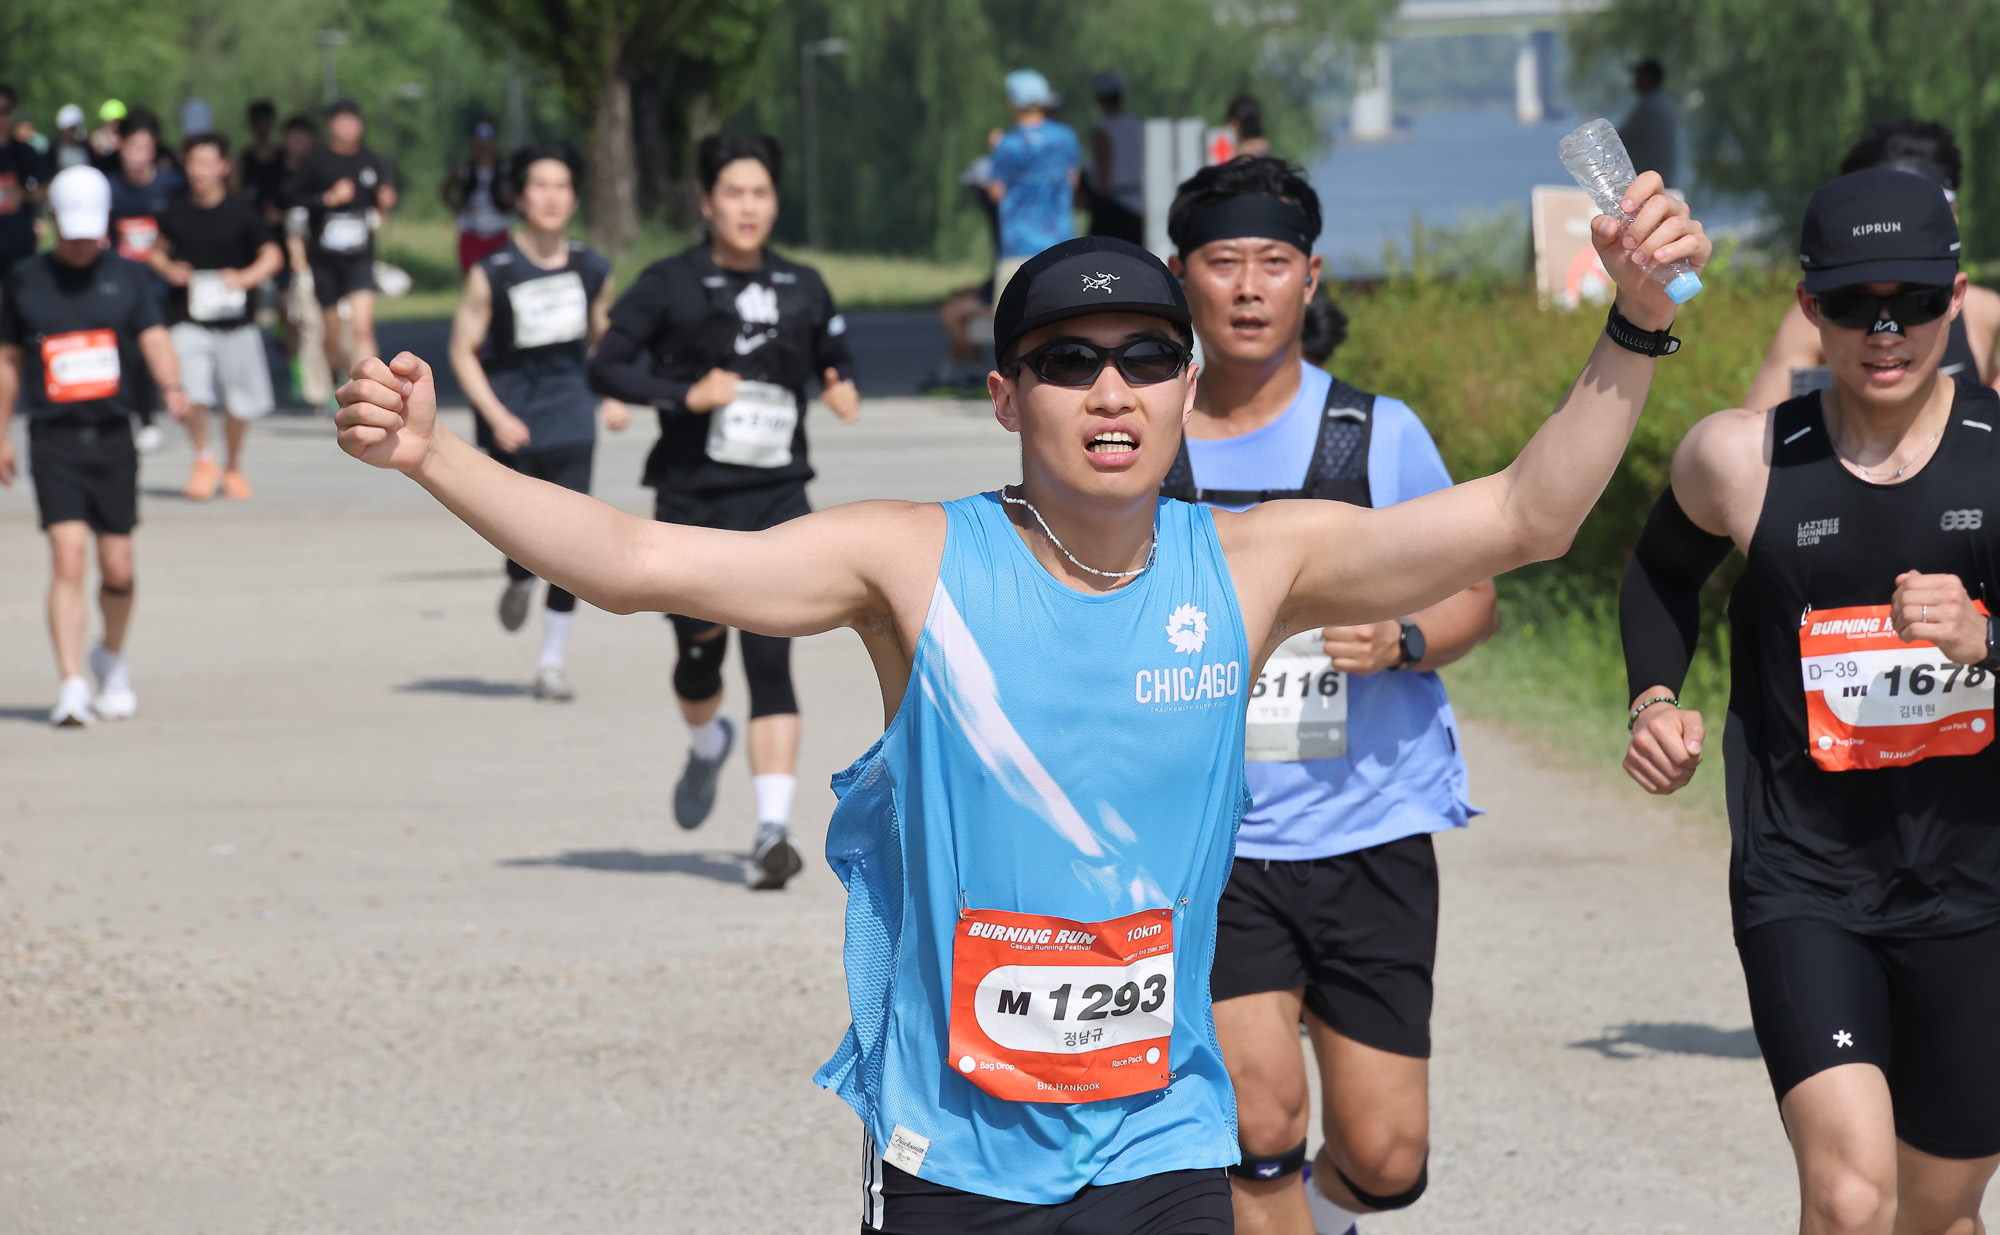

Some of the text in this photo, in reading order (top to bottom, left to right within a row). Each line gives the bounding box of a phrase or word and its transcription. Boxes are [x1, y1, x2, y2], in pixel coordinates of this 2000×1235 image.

[1852, 221, 1901, 237] KIPRUN
[1797, 536, 1820, 547] CLUB
[1810, 618, 1880, 636] BURNING
[1809, 661, 1858, 681] D-39
[1884, 663, 1987, 697] 1678
[1136, 661, 1240, 704] CHICAGO
[1900, 703, 1936, 718] 김태현
[968, 921, 1097, 945] BURNING RUN
[1126, 923, 1162, 942] 10km
[1010, 942, 1034, 951] Casual
[1035, 944, 1063, 952] Running
[997, 973, 1167, 1021] M 1293
[1064, 1028, 1104, 1047] 정남규
[980, 1061, 1015, 1072] Bag Drop
[1112, 1054, 1143, 1068] Race Pack
